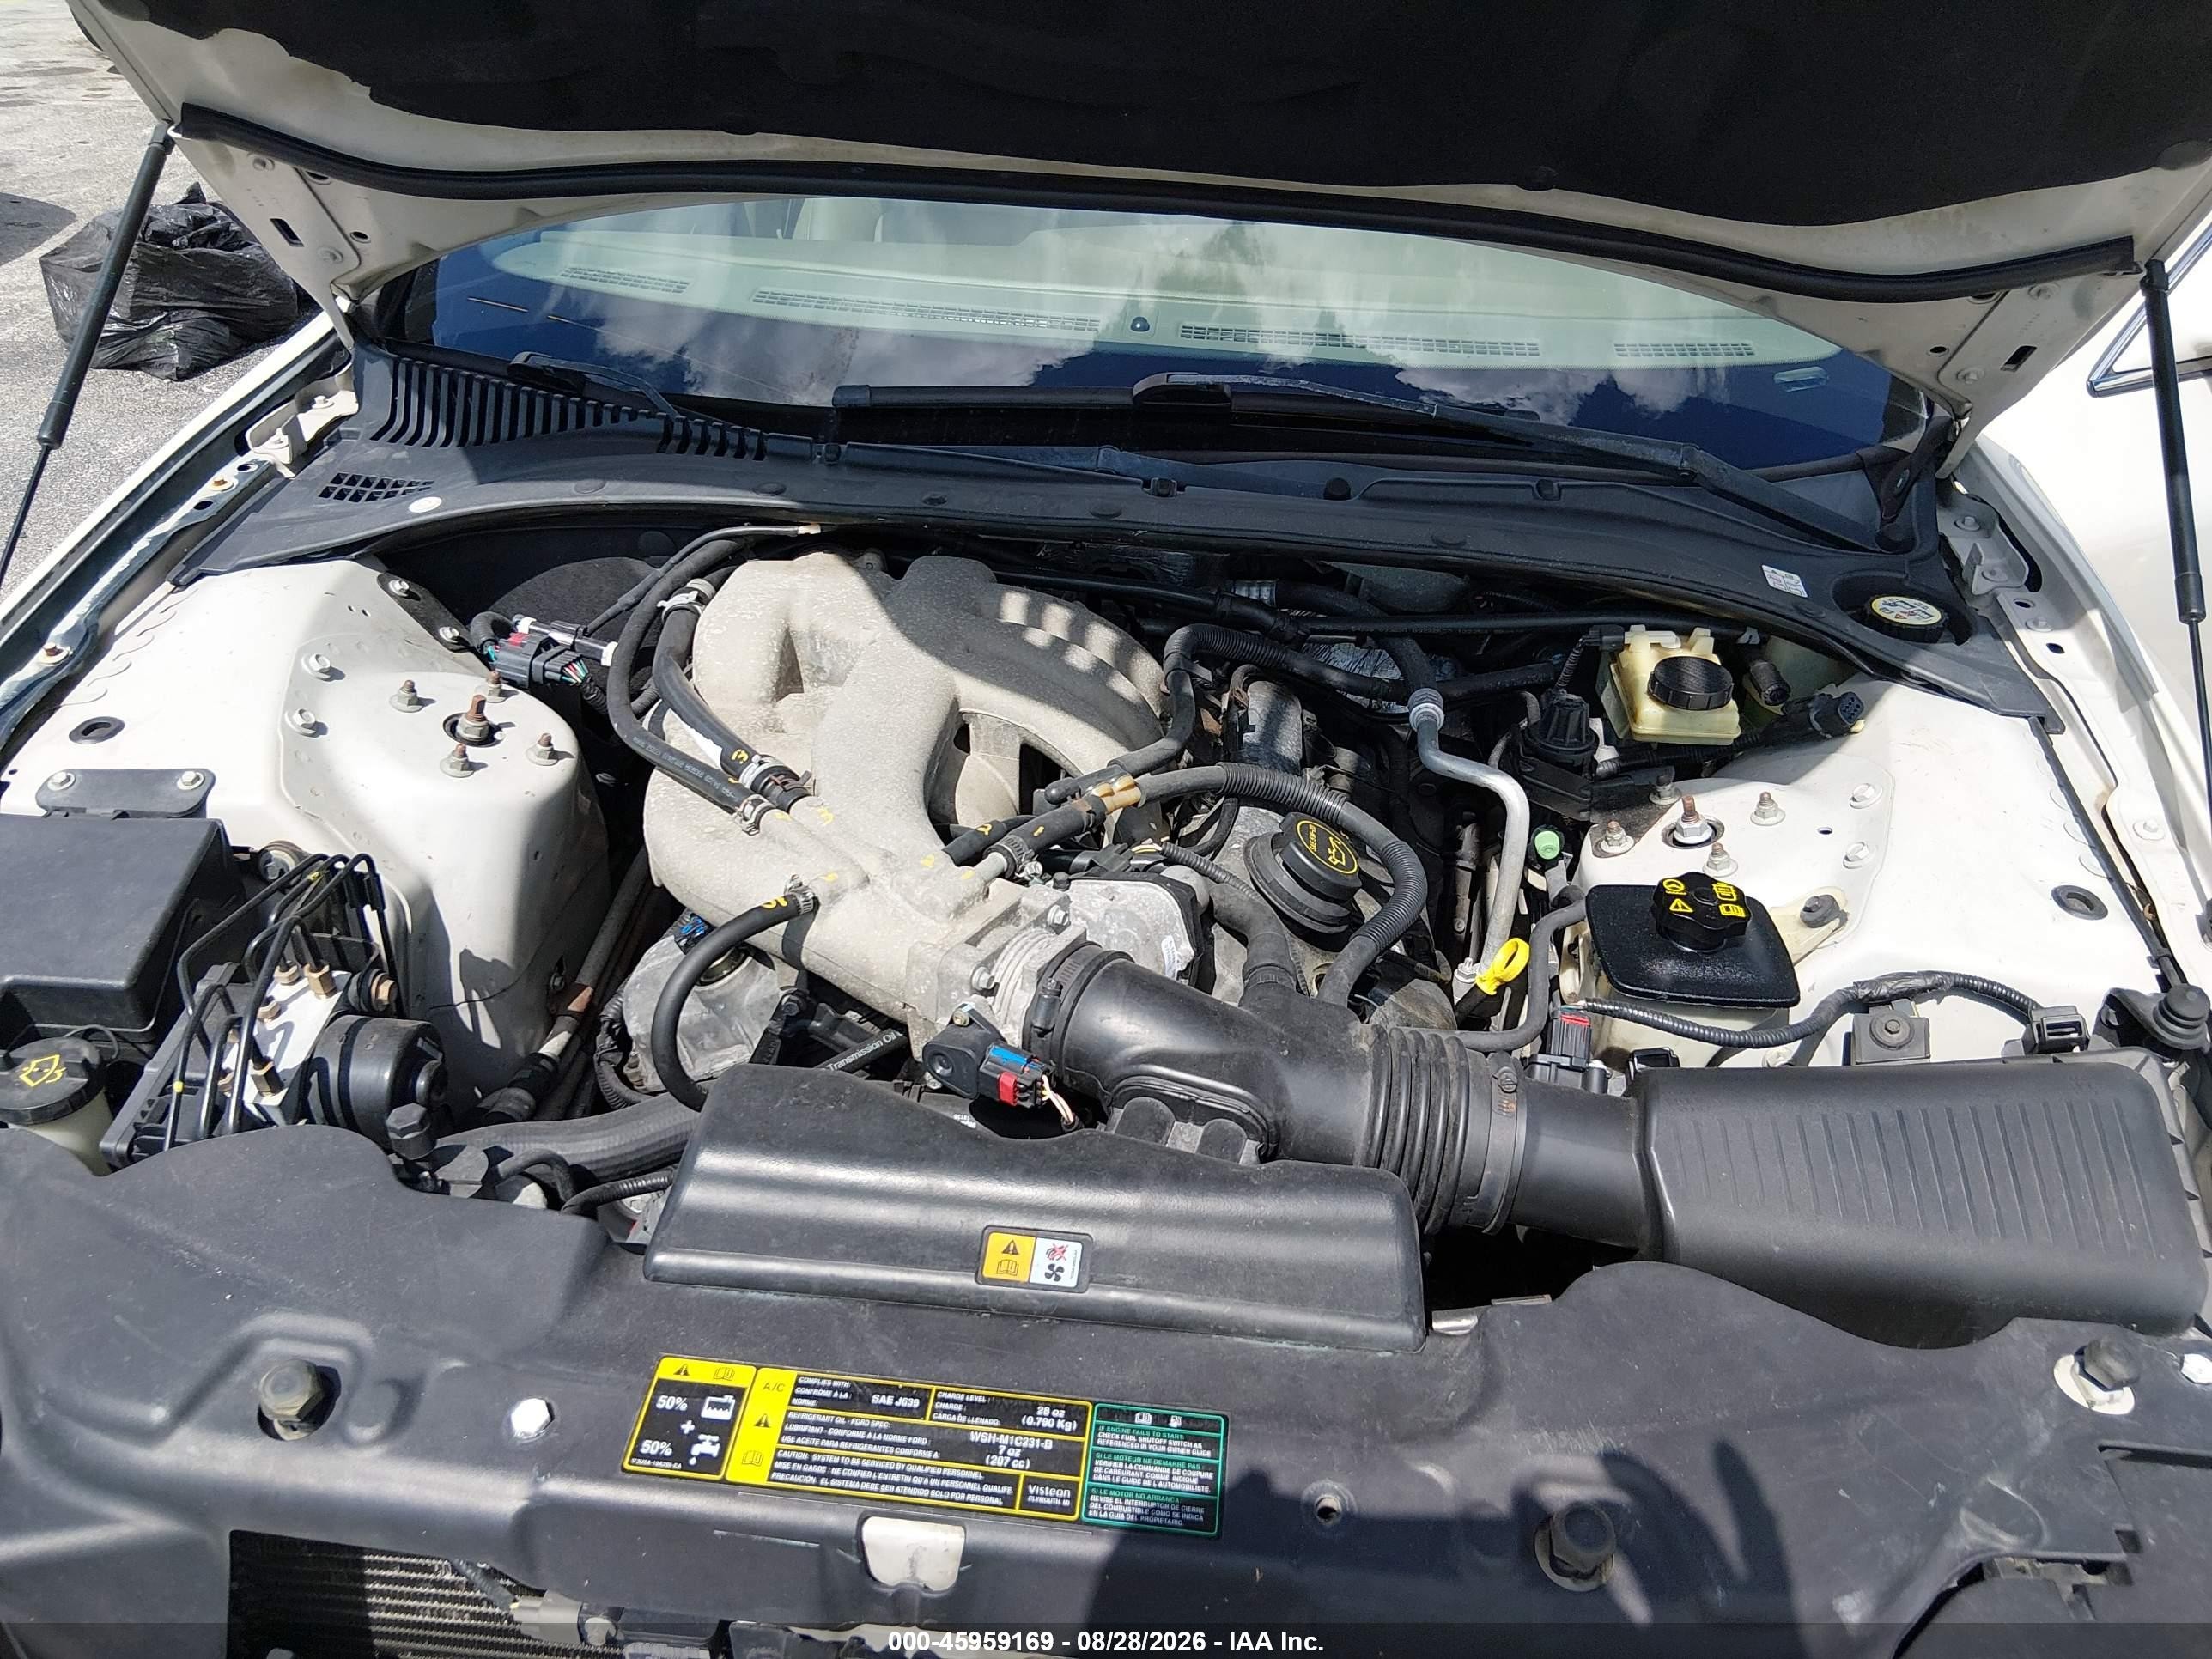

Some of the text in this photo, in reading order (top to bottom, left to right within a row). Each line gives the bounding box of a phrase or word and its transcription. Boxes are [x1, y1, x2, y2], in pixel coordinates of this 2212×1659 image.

[825, 1039, 884, 1072] Transmission
[798, 1376, 832, 1387] COMPLIES
[656, 1395, 688, 1412] 50%
[872, 1395, 921, 1408] SAE J639
[965, 1395, 987, 1403] LEVEL
[788, 1411, 835, 1424] REFRIGERANT
[835, 1415, 847, 1425] OIL
[850, 1417, 870, 1427] FORD
[933, 1413, 957, 1422] CARGA
[1056, 1419, 1078, 1432] Kg)
[785, 1424, 824, 1434] LUBRIFIANT
[828, 1427, 866, 1438] CONFORME
[883, 1432, 908, 1443] NORME
[908, 1436, 927, 1446] FORD
[970, 1431, 1053, 1450] WSH-M1C231-B
[1139, 1436, 1167, 1444] SHUTOFF
[1168, 1439, 1193, 1448] SWITCH
[641, 1439, 673, 1456] 50%
[781, 1436, 795, 1444] USE
[796, 1437, 821, 1447] ACEITE
[821, 1439, 839, 1449] PARA
[840, 1441, 895, 1454] REFRIGERANTES
[999, 1444, 1006, 1455] 7
[1097, 1438, 1140, 1449] REFERENCED
[1167, 1446, 1192, 1455] OWNER
[776, 1449, 809, 1460] CAUTION:
[812, 1453, 840, 1463] SYSTEM
[841, 1456, 850, 1465] TO
[862, 1458, 895, 1470] SERVICED
[907, 1463, 942, 1475] QUALIFIED
[986, 1454, 1011, 1468] (207
[1113, 1454, 1142, 1463] MOTEUR
[775, 1461, 792, 1470] MISE
[802, 1463, 827, 1473] GARDE
[831, 1467, 842, 1475] NE
[941, 1479, 981, 1491] PERSONNEL
[1092, 1473, 1112, 1481] DANS
[1121, 1475, 1142, 1485] GUIDE
[1133, 1463, 1171, 1474] COMMANDE
[1171, 1467, 1182, 1475] DE
[1182, 1468, 1214, 1480] COUPURE
[1146, 1471, 1170, 1480] COMME
[819, 1477, 830, 1486] EL
[830, 1478, 860, 1489] SISTEMA
[860, 1482, 879, 1491] DEBE
[879, 1484, 895, 1492] SER
[895, 1486, 929, 1496] ATENDIDO
[931, 1489, 950, 1498] SOLO
[950, 1492, 966, 1501] POR
[1028, 1483, 1071, 1498] Visteon
[1109, 1490, 1134, 1498] MOTOR
[1090, 1494, 1115, 1503] REVISE
[1124, 1498, 1170, 1510] INTERRUPTOR
[1182, 1504, 1205, 1514] CIERRE
[1103, 1504, 1150, 1515] COMBUSTIBLE
[1182, 1512, 1204, 1522] INDICA
[1140, 1516, 1183, 1526] PROPIETARIO
